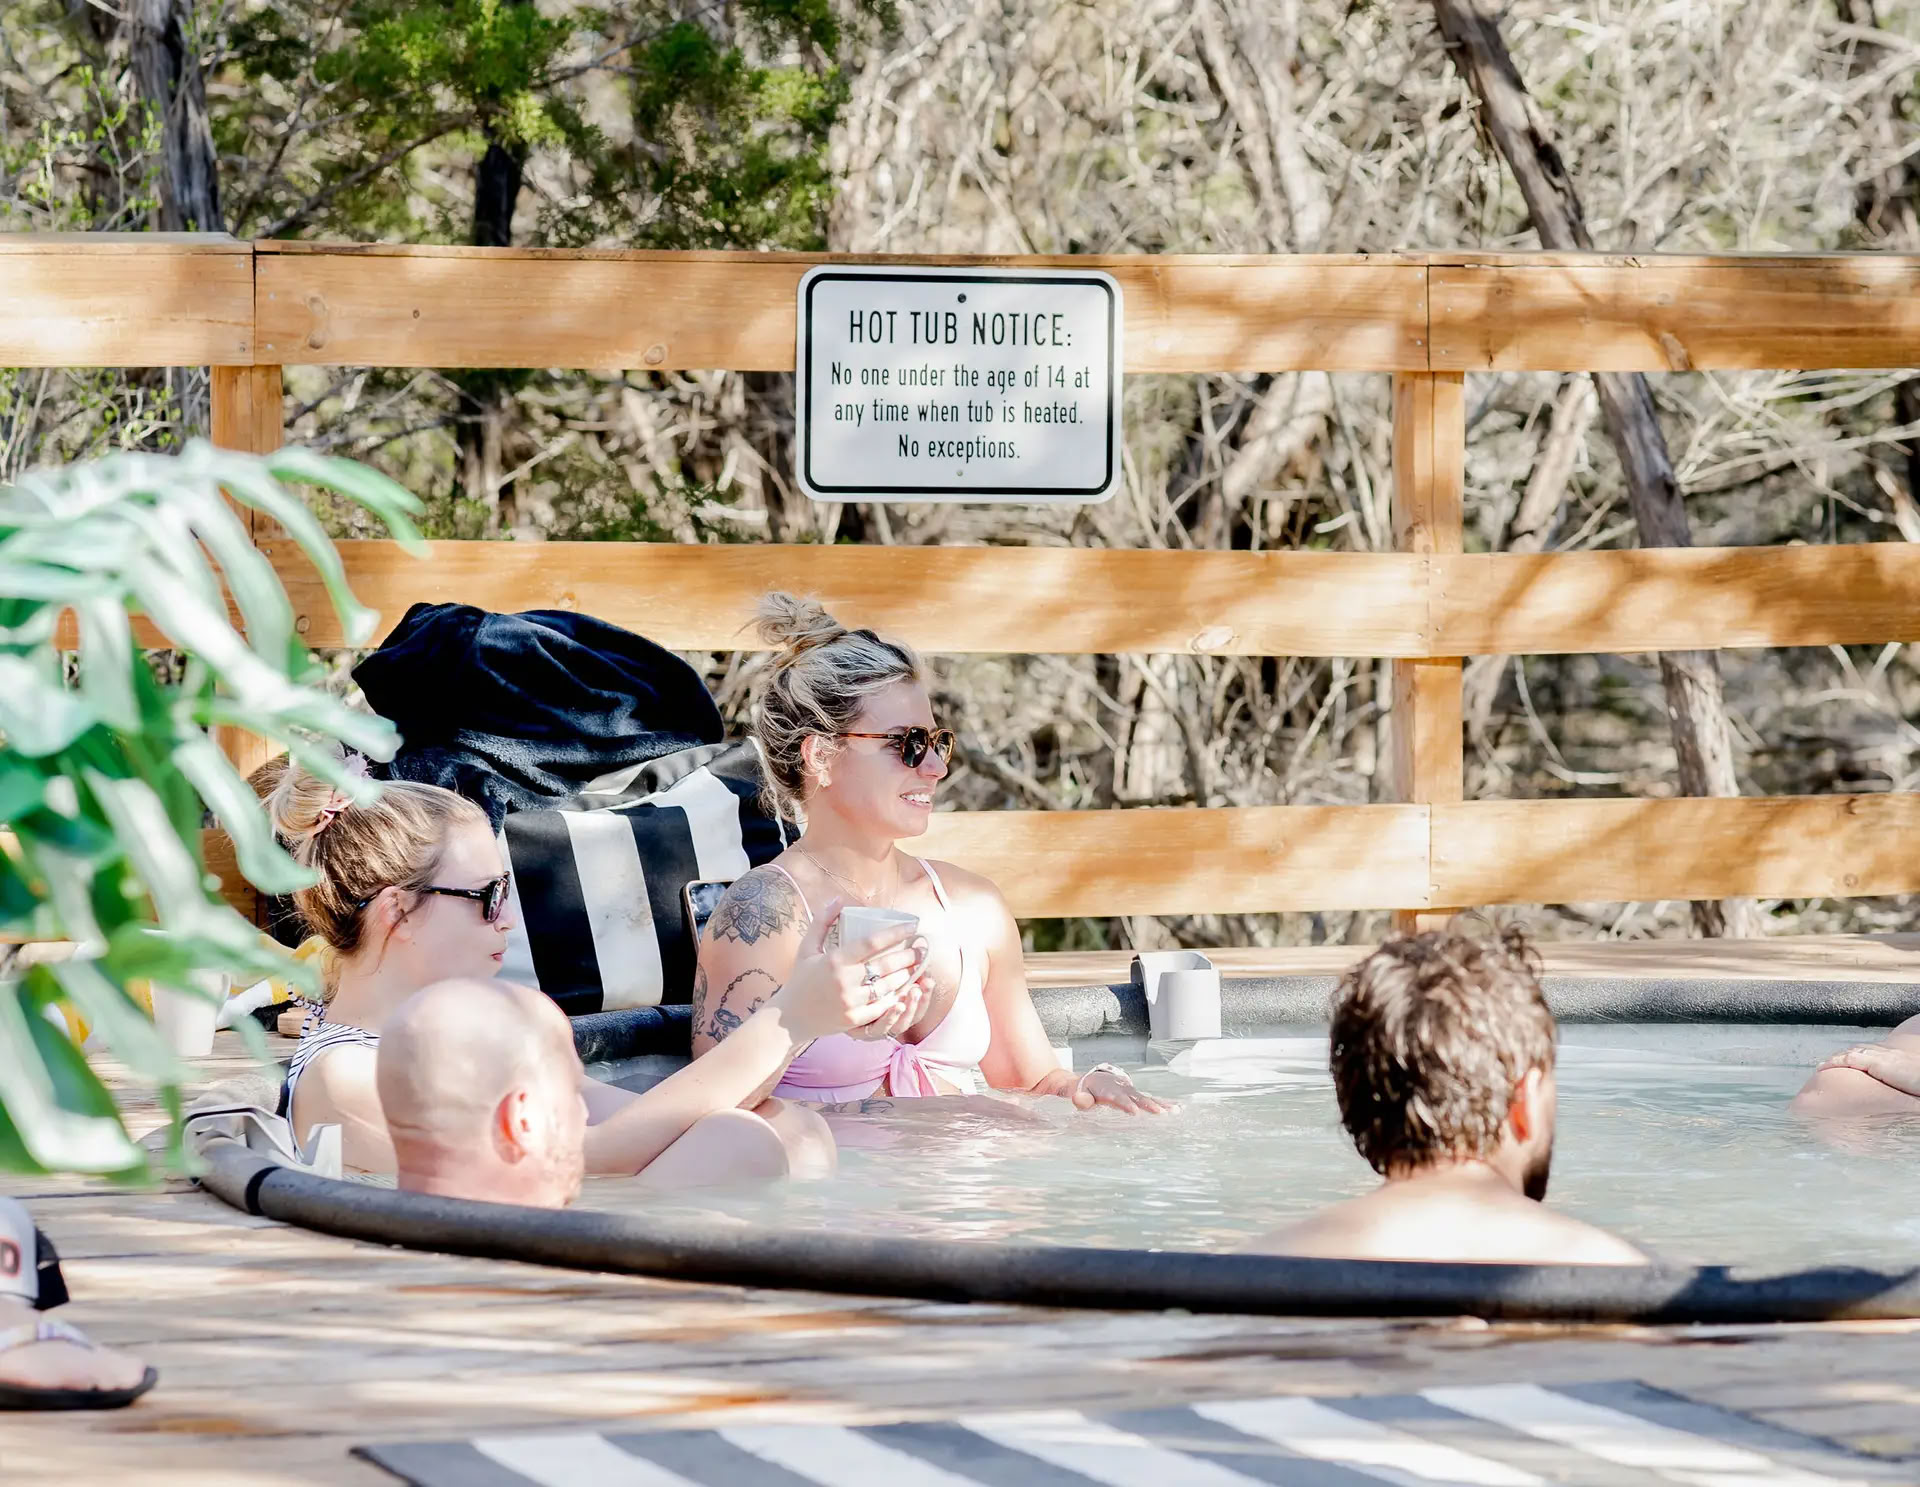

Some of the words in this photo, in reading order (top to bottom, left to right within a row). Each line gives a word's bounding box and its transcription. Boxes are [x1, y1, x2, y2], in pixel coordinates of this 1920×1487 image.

[850, 310, 897, 343] HOT
[910, 311, 957, 344] TUB
[973, 312, 1071, 346] NOTICE:
[832, 362, 851, 385] No
[861, 369, 889, 386] one
[899, 364, 945, 386] under
[954, 365, 979, 387] the
[987, 371, 1015, 394] age
[1024, 365, 1039, 387] of
[1047, 365, 1065, 388] 14
[1075, 367, 1090, 388] at
[835, 404, 864, 427] any
[872, 399, 908, 422] time
[918, 400, 958, 422] when
[967, 400, 993, 422] tub
[1003, 400, 1015, 422] is
[1025, 401, 1083, 424] heated.
[899, 434, 919, 457] No
[928, 436, 1020, 463] exceptions.
